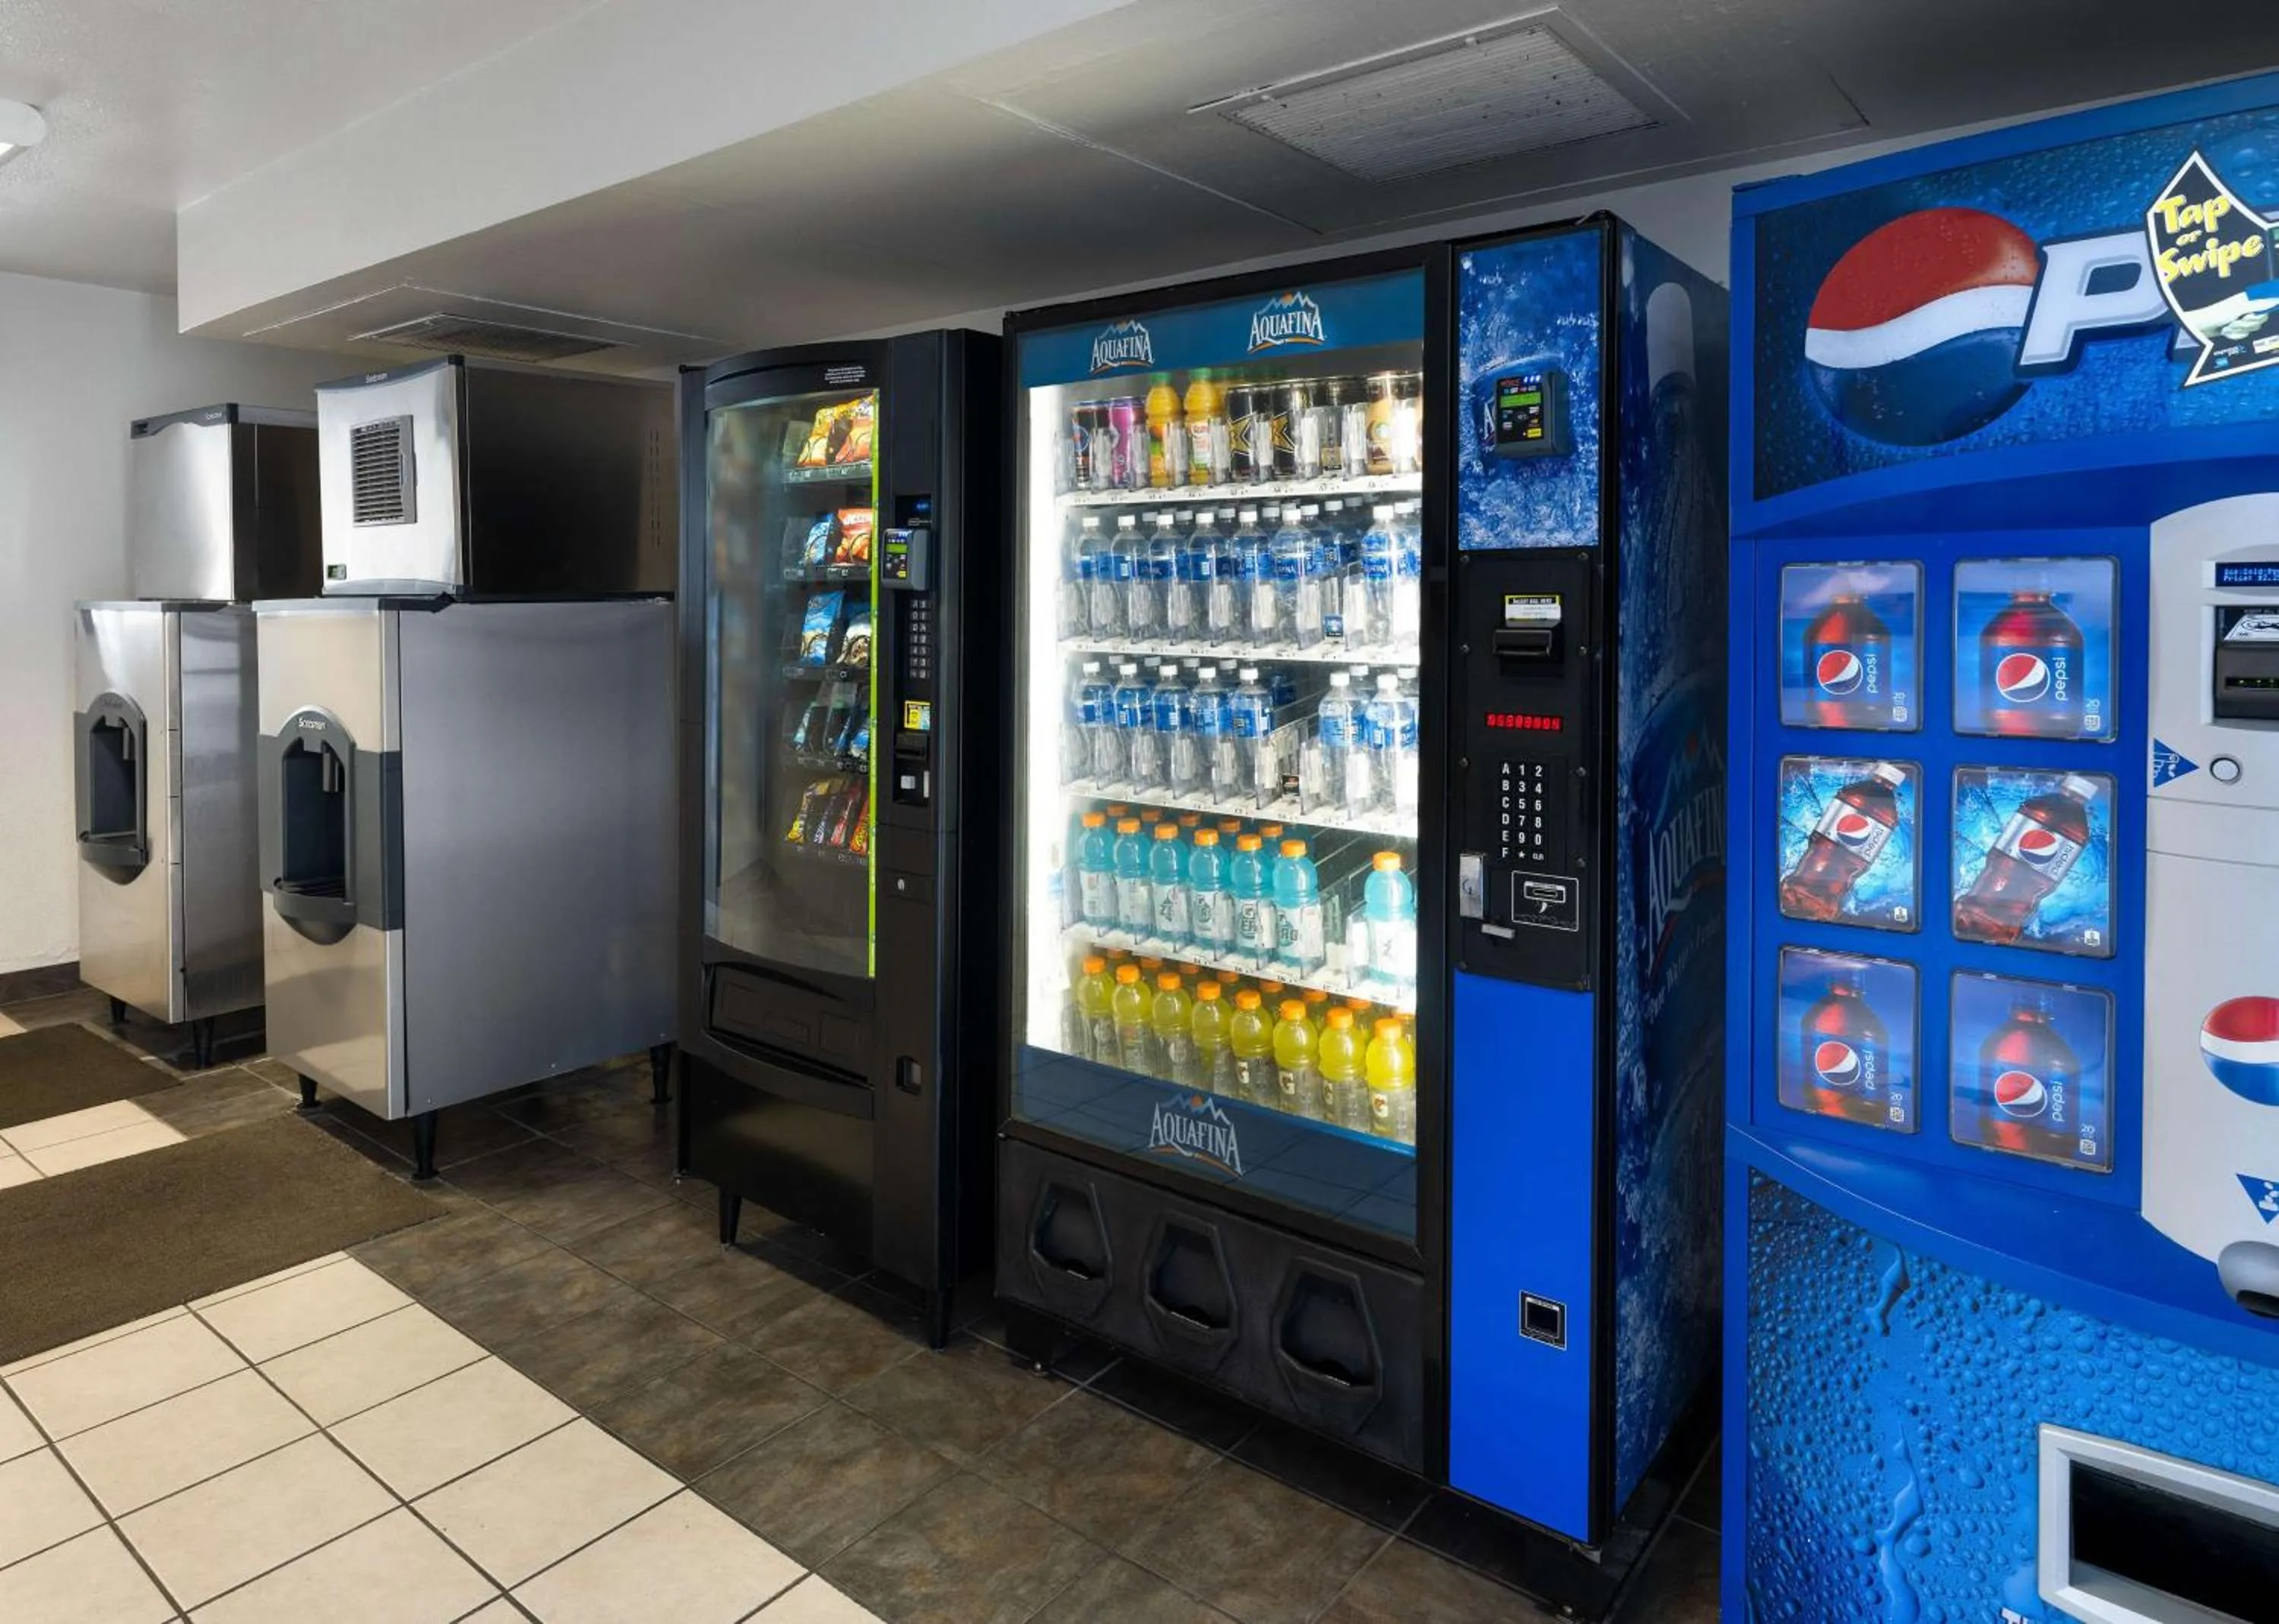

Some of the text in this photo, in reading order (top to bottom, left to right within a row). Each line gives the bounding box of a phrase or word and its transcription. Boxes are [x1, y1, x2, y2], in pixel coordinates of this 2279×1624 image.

[2156, 194, 2231, 234] Tap
[2176, 230, 2202, 246] or
[2159, 235, 2265, 283] Swipe
[1248, 309, 1325, 350] AQUAFINA
[1090, 331, 1155, 371] AQUAFINA
[2054, 656, 2067, 702] pepsi
[1502, 763, 1543, 777] A 1 2
[1502, 779, 1542, 794] B 3 4
[1502, 797, 1542, 811] C 5 6
[1502, 814, 1542, 828] D 7 8
[1502, 830, 1542, 845] E 9 0
[1502, 847, 1509, 858] F
[1648, 785, 1727, 975] AQUAFIN
[1149, 1101, 1244, 1177] AQUAFINA
